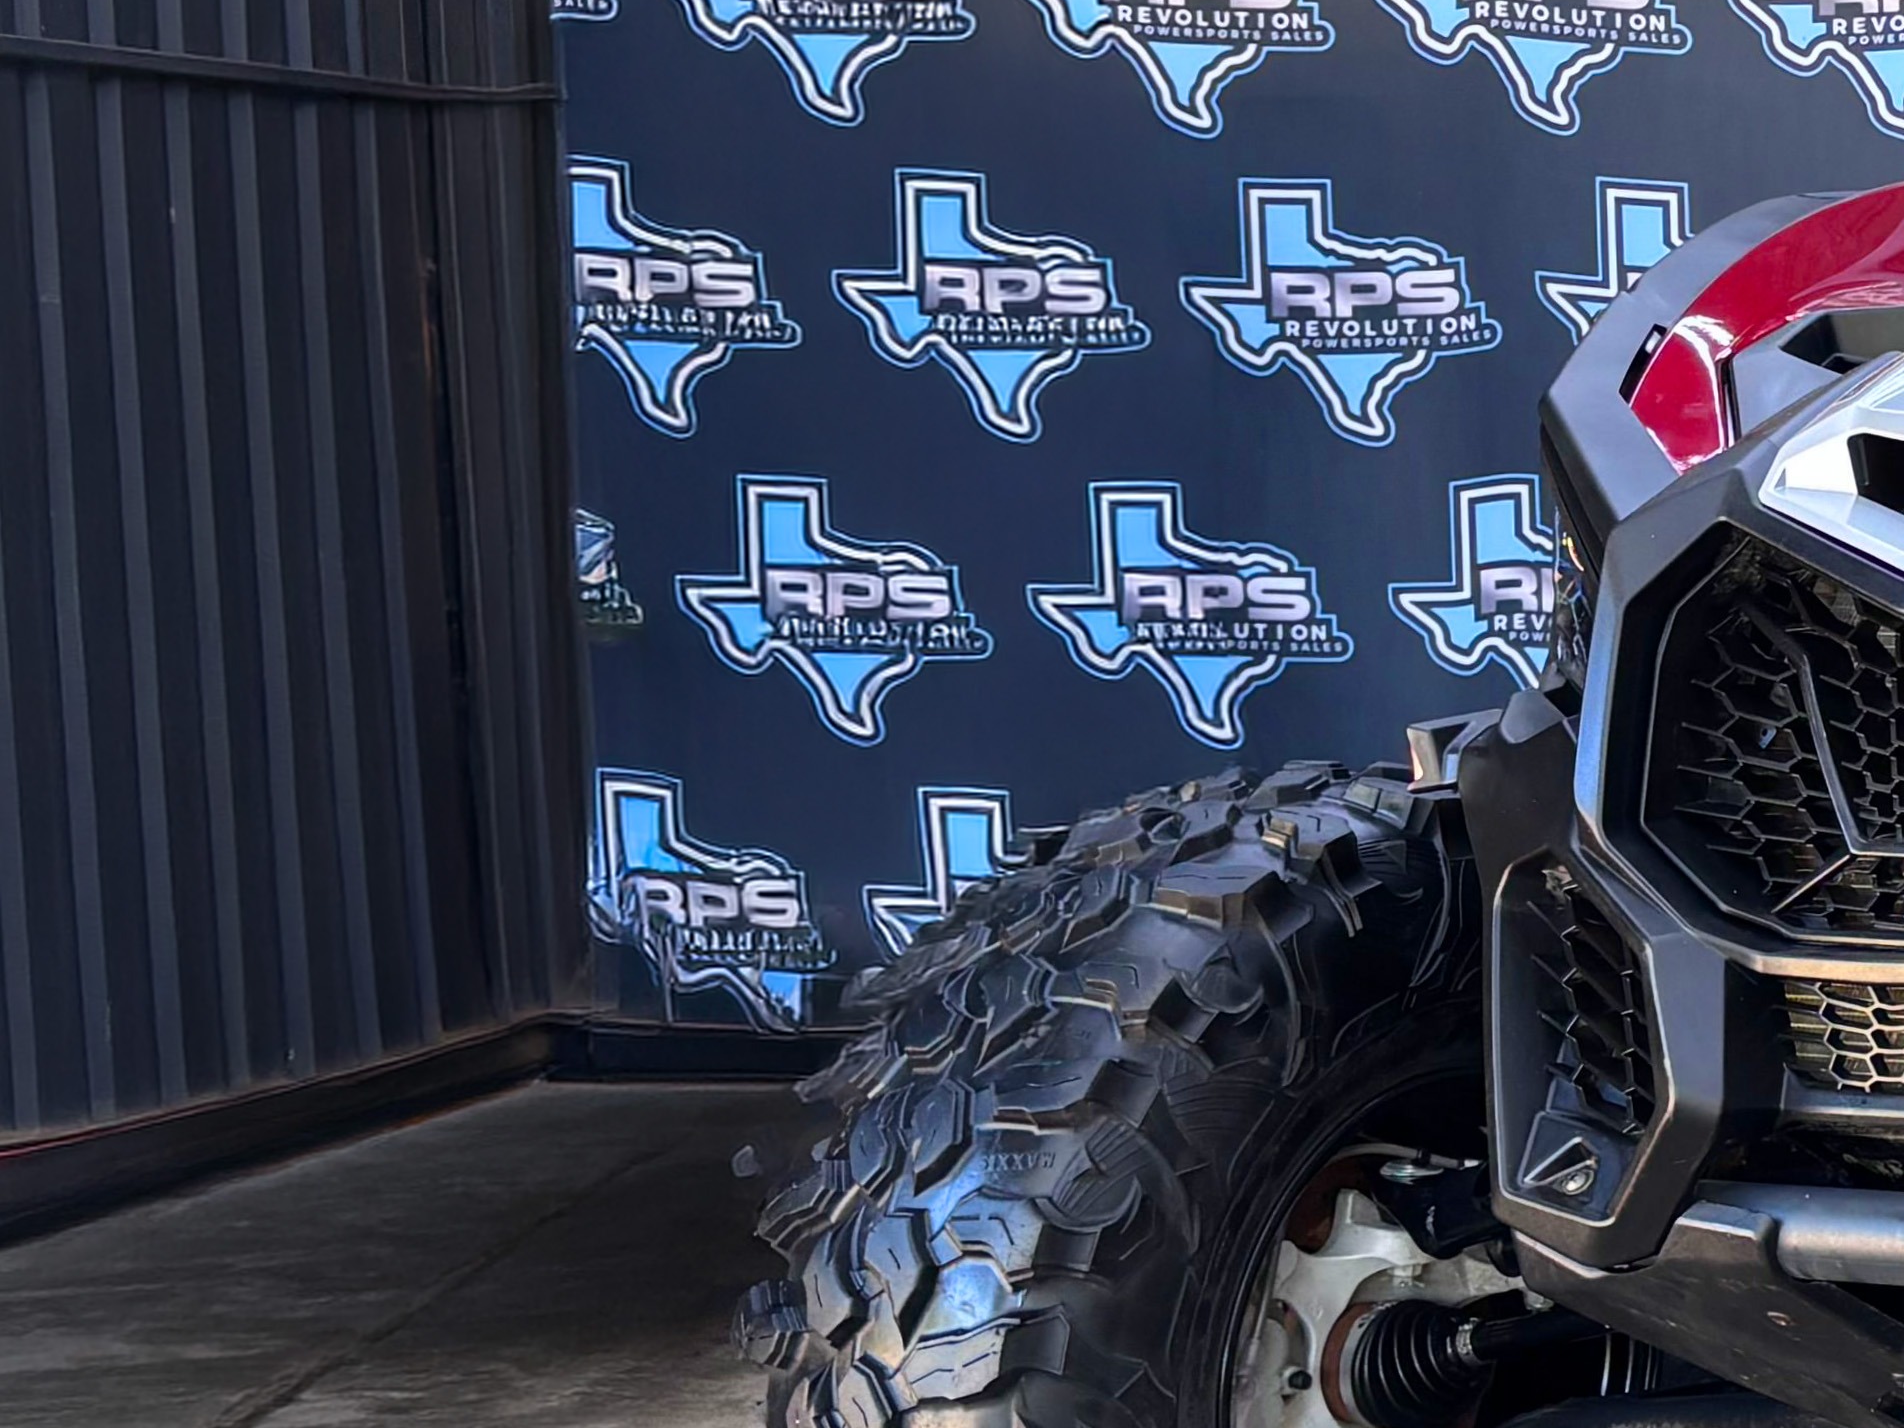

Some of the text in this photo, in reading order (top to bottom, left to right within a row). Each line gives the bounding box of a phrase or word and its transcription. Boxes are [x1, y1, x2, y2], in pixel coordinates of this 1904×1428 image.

[1118, 5, 1308, 29] REVOLUTION
[1476, 0, 1665, 32] REVOLUTION
[1491, 19, 1680, 44] POWERSPORTS SALES
[1271, 269, 1460, 317] RPS
[1286, 314, 1475, 336] REVOLUTION
[1302, 330, 1491, 348] POWERSPORTS SALES
